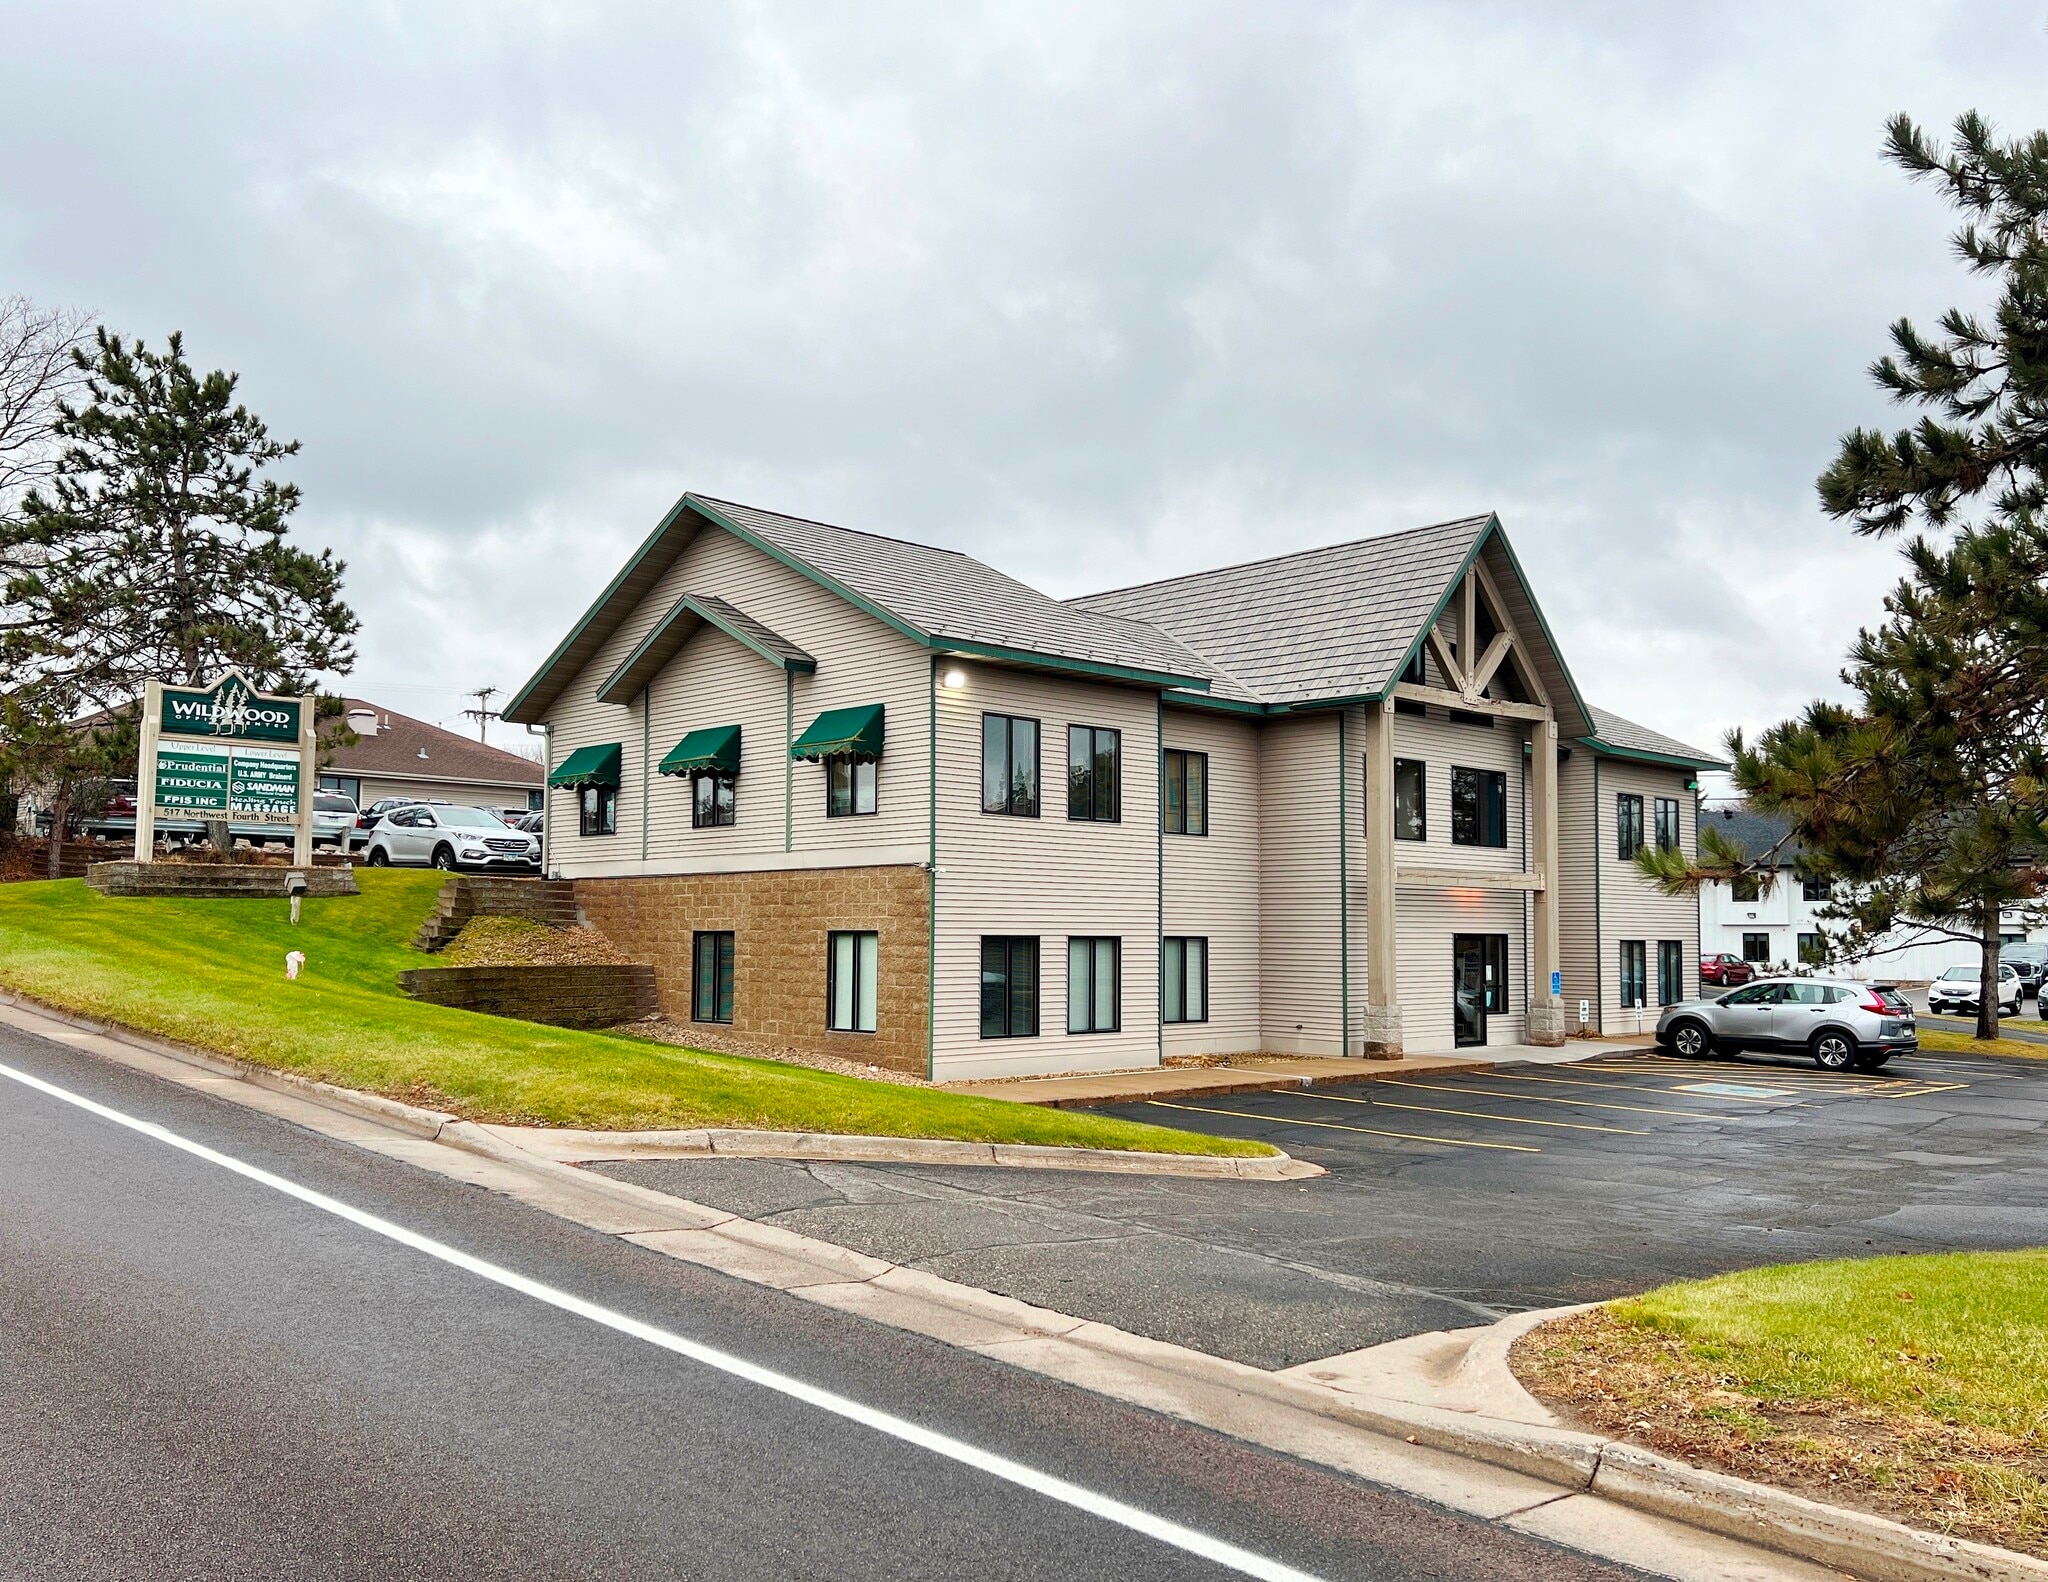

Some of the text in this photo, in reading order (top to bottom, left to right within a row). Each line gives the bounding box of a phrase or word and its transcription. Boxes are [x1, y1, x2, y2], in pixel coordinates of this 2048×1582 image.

[172, 701, 290, 723] WILDWOOD
[241, 720, 288, 729] ENTER
[171, 742, 216, 753] Upper Level
[244, 749, 288, 759] Lower Level
[168, 761, 226, 773] Prudential
[233, 759, 297, 771] Company Headquarters
[160, 778, 222, 789] FIDUCIA
[246, 782, 295, 793] SANDMAN
[164, 795, 218, 806] FPIS INC
[230, 796, 266, 805] Healing
[230, 802, 297, 814] MASSAGE
[163, 808, 290, 822] 517 Northwest Fourth Street
